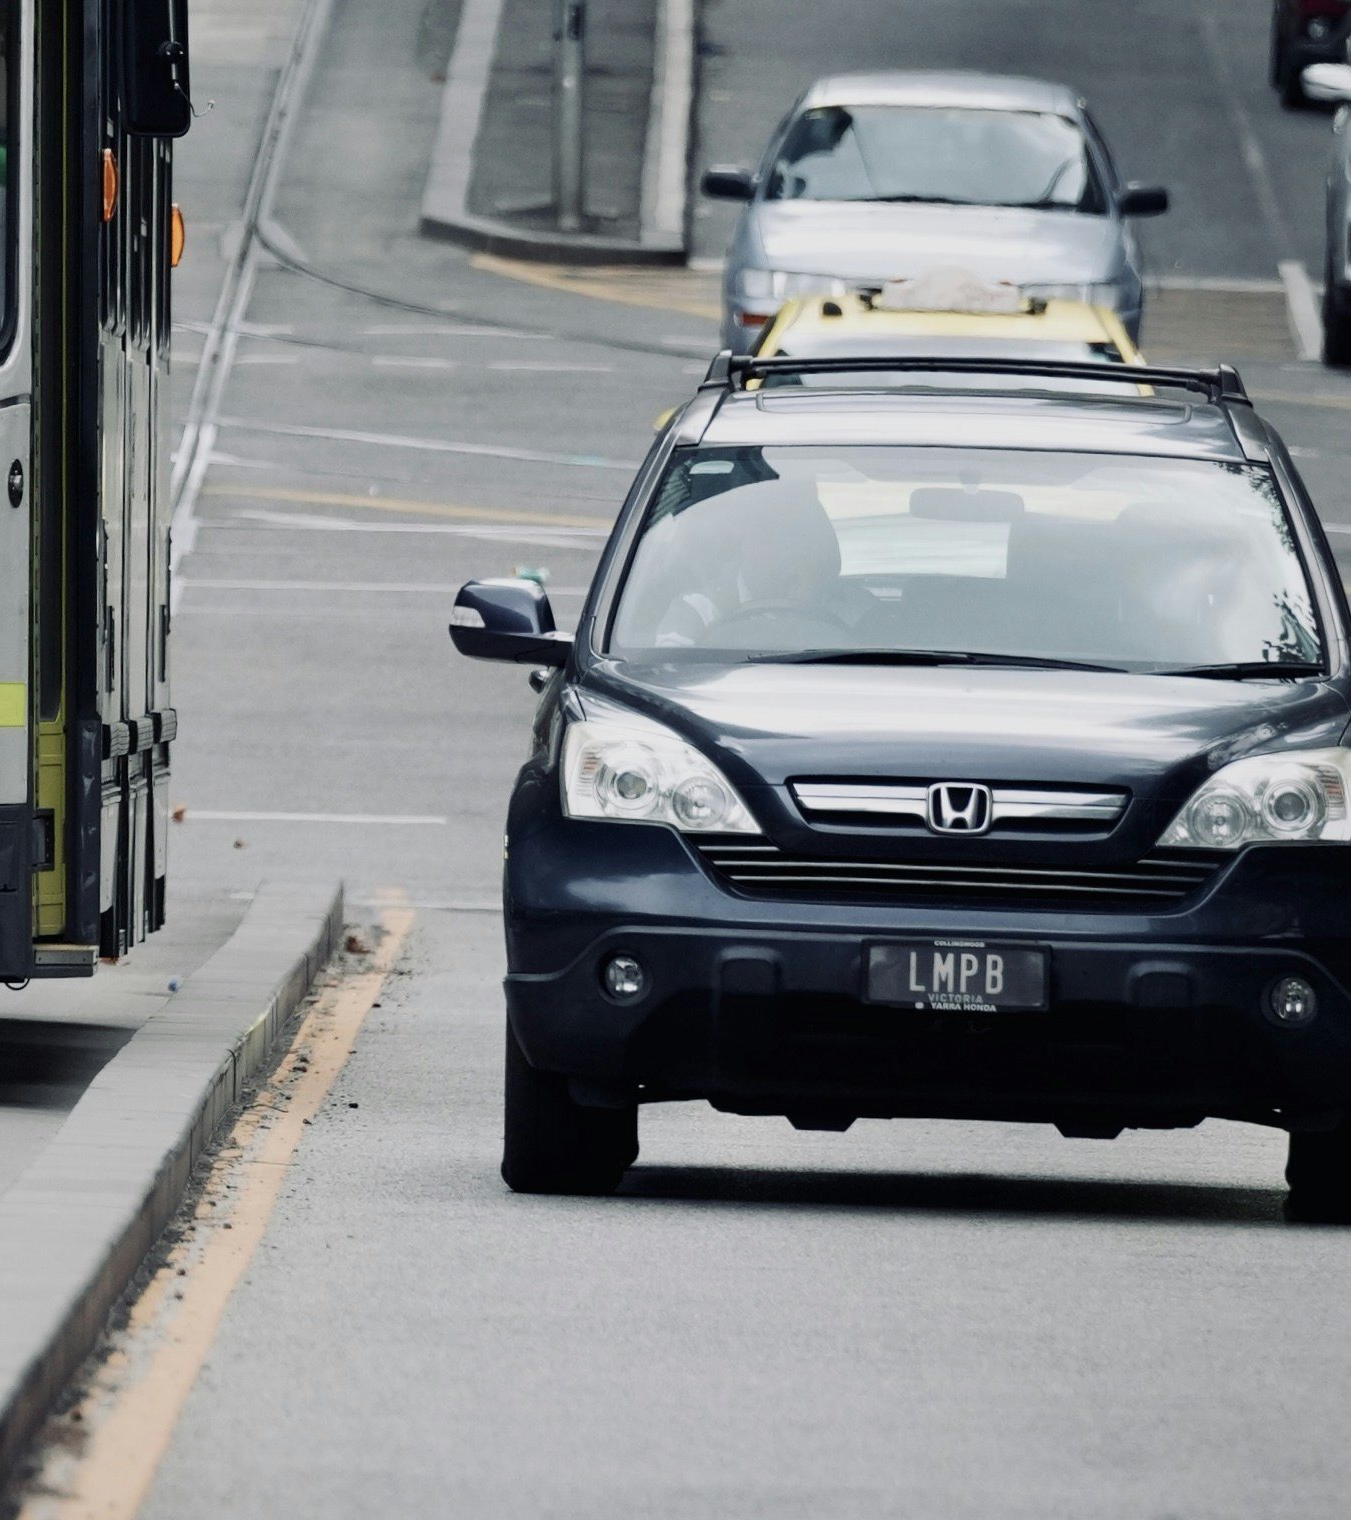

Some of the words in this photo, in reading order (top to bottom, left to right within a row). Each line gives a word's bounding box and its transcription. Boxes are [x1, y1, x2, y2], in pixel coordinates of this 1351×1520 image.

[909, 951, 1004, 995] LMPB
[928, 993, 983, 1003] VICTORIA
[930, 1002, 962, 1010] YARRA
[963, 1003, 997, 1012] HONDA
